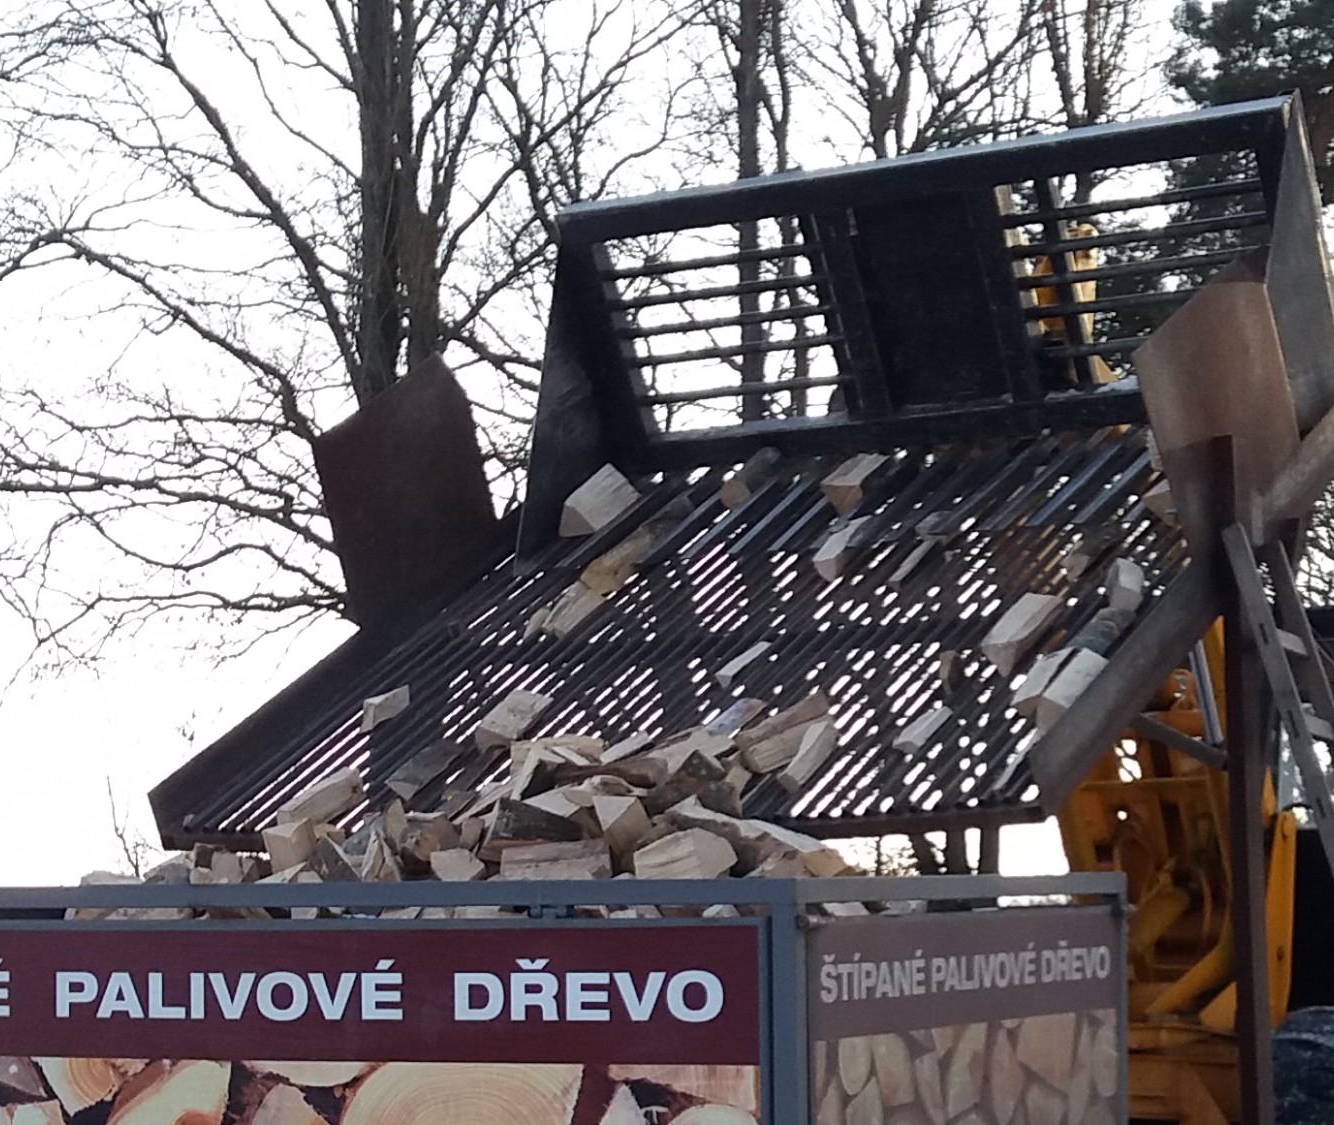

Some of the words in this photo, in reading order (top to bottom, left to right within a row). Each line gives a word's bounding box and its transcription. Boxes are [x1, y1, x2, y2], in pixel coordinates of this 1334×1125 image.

[55, 958, 404, 1022] PALIVOVÉ
[453, 958, 724, 1023] DŘEVO
[820, 948, 926, 1003] ŠTÍPANÉ
[931, 942, 1037, 993] PALIVOVÉ
[1041, 939, 1112, 983] DŘEVO
